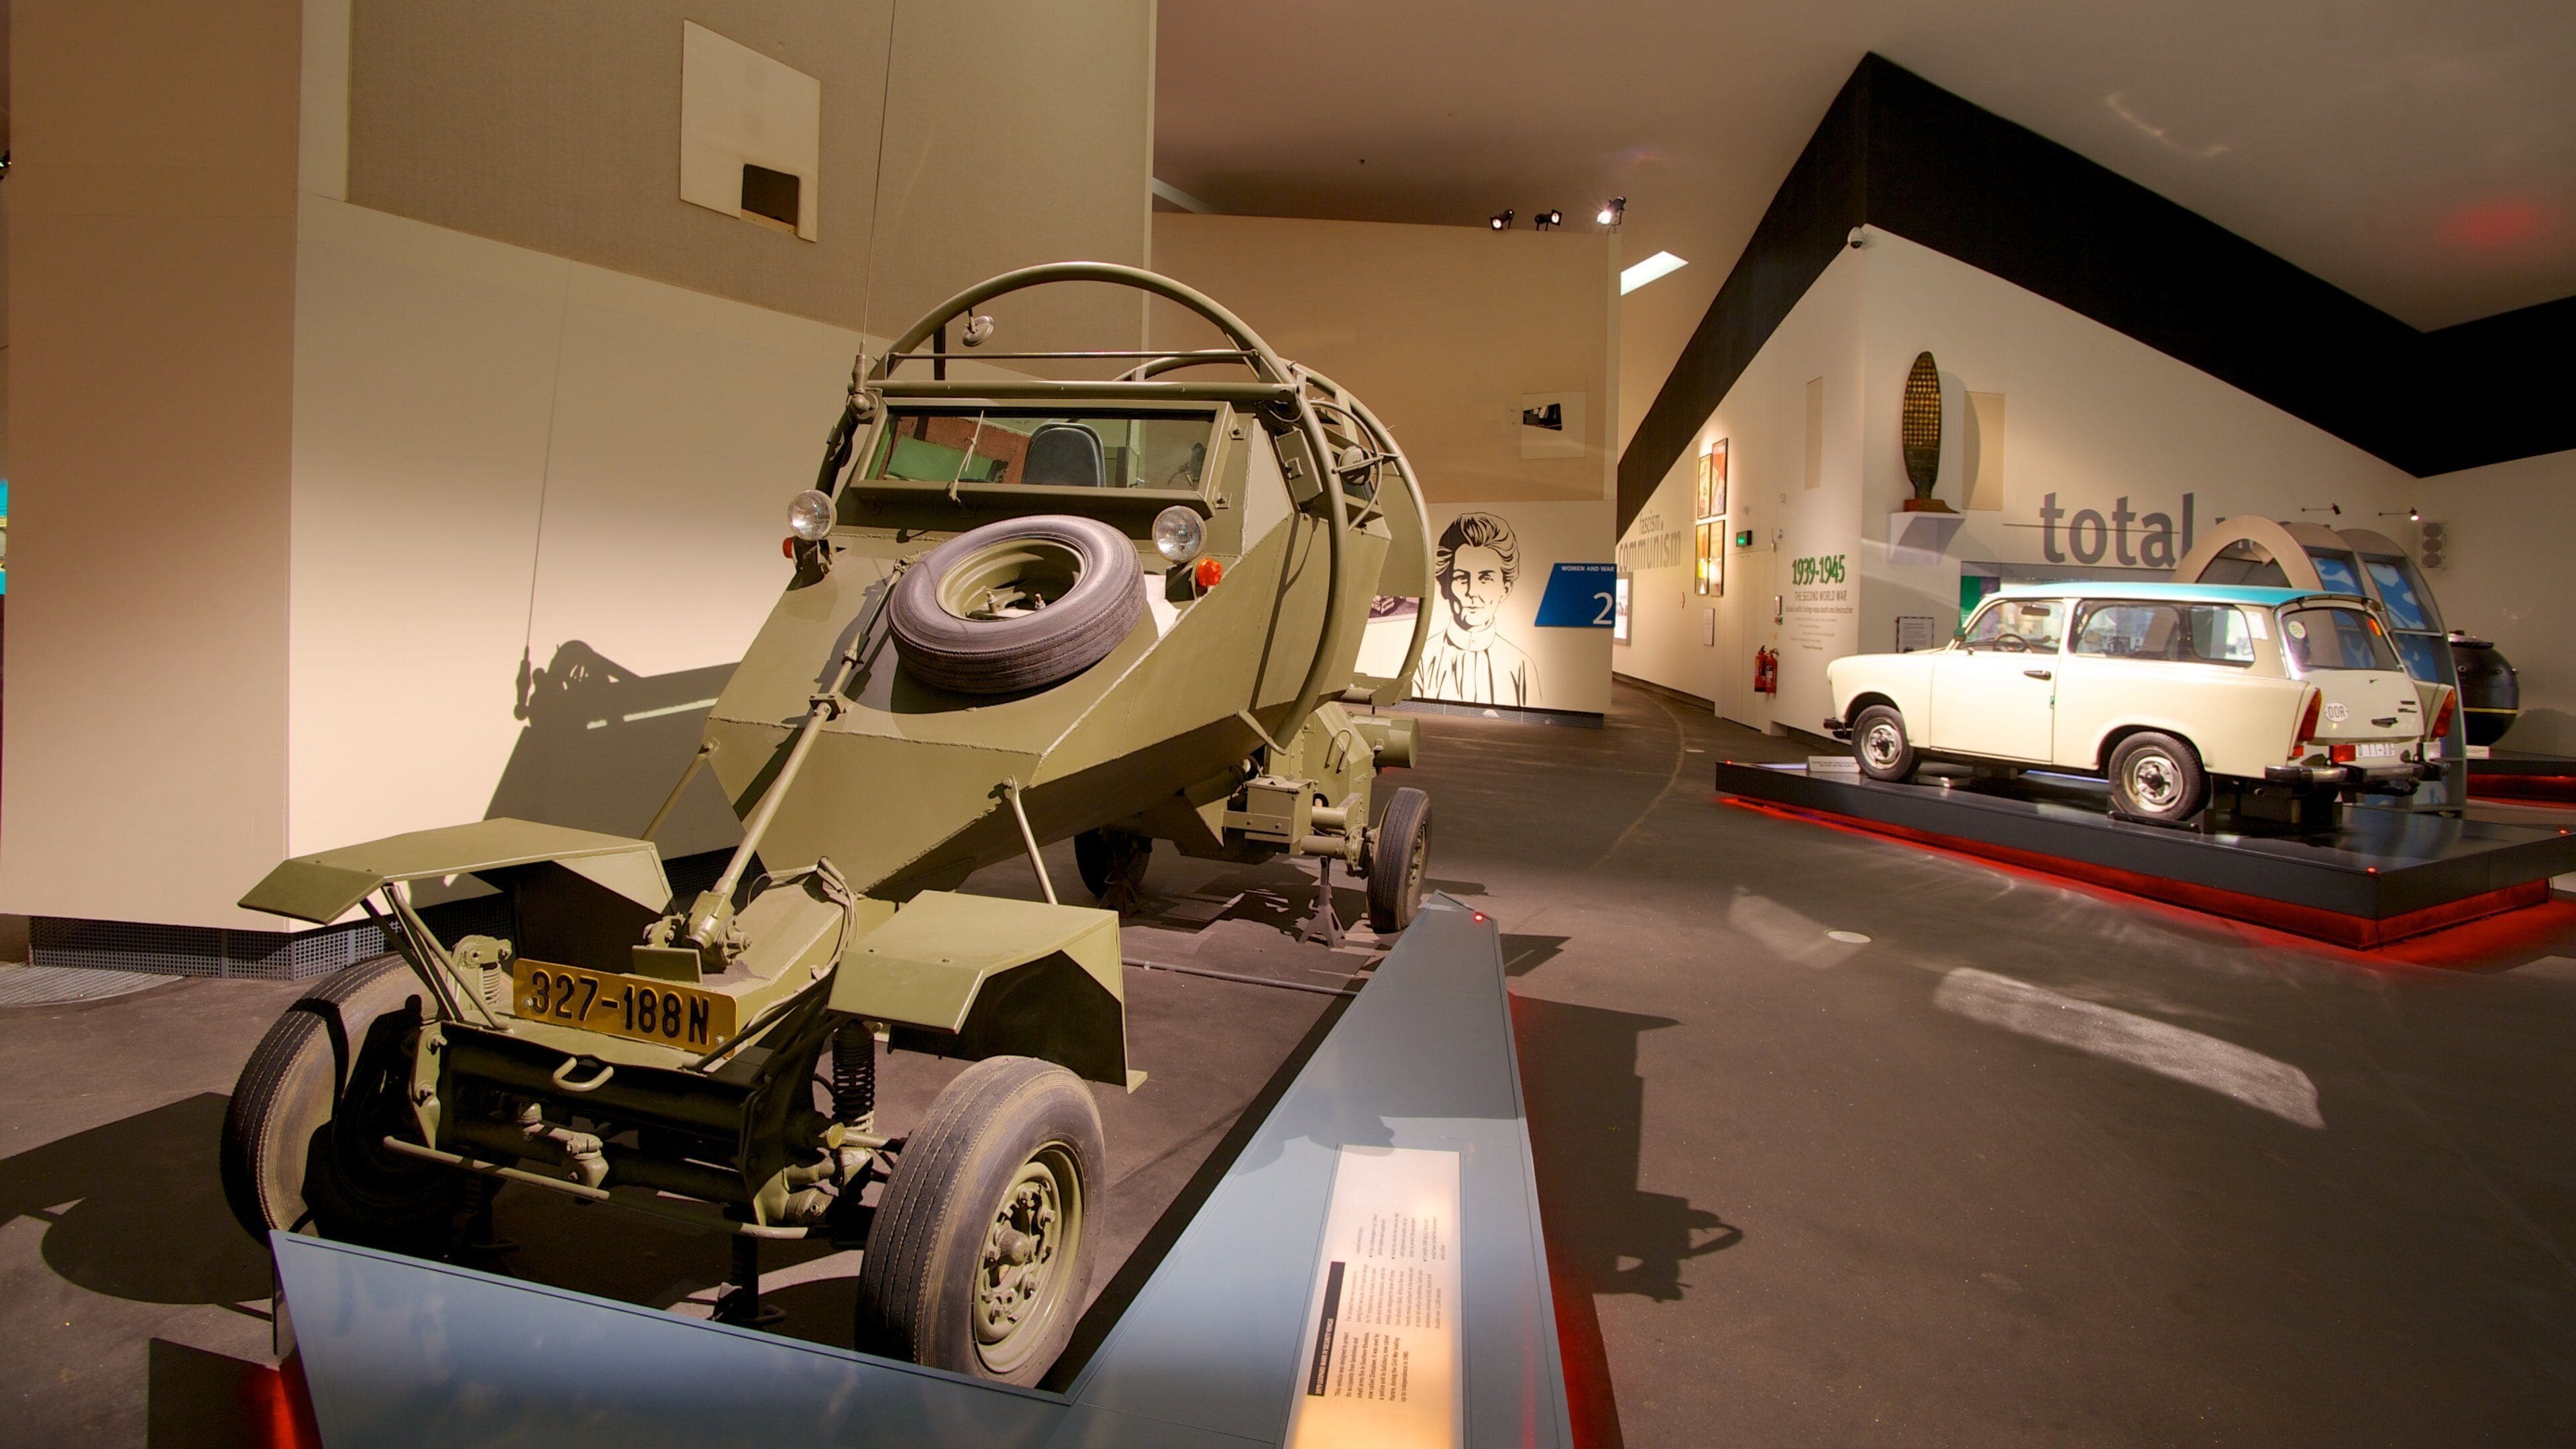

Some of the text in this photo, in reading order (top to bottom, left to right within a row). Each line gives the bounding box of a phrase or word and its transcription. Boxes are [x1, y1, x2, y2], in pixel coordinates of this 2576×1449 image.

[1619, 521, 1681, 572] communism
[2039, 492, 2194, 568] total
[1792, 554, 1846, 586] 1939-1945
[1593, 592, 1613, 625] 2
[1820, 590, 1835, 601] WORLD
[1836, 590, 1847, 601] WAR
[2327, 706, 2346, 718] DDR
[532, 969, 710, 1046] 327-188N
